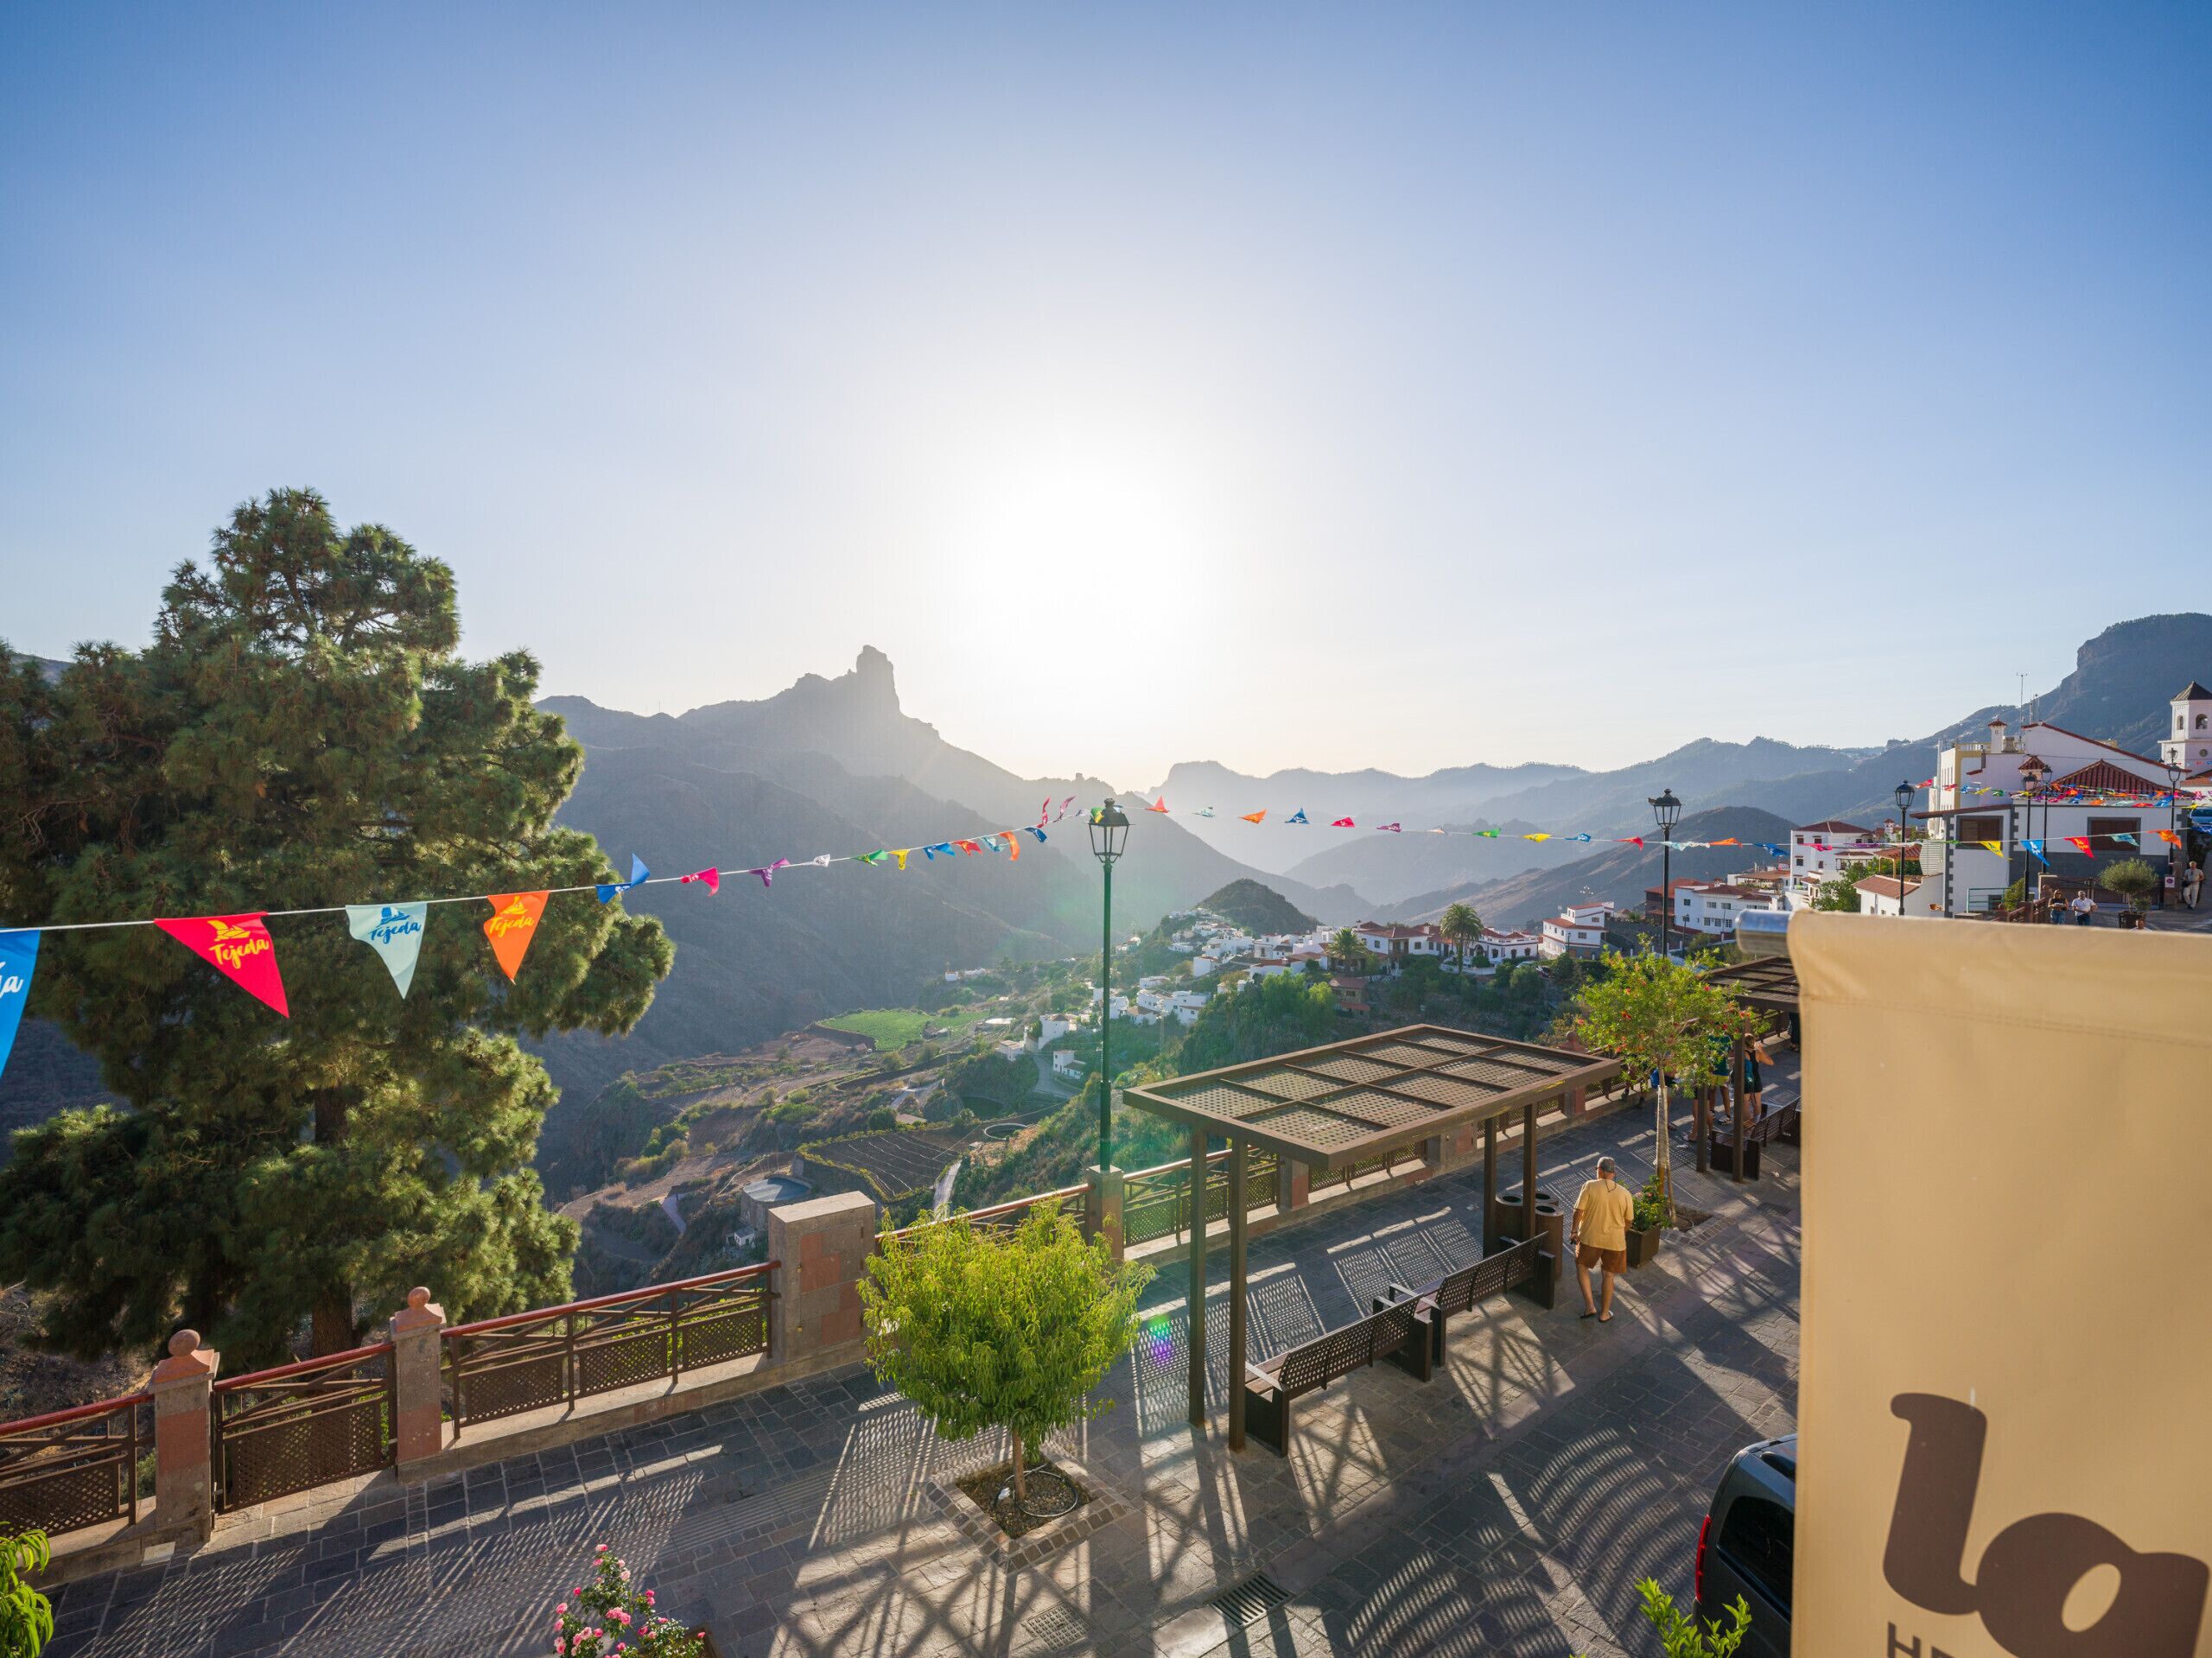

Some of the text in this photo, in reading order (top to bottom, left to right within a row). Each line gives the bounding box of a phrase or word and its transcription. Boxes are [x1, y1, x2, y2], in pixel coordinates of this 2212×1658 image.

[369, 922, 421, 944] Tejeda
[489, 916, 534, 937] Tejeda
[208, 938, 270, 969] Tejeda
